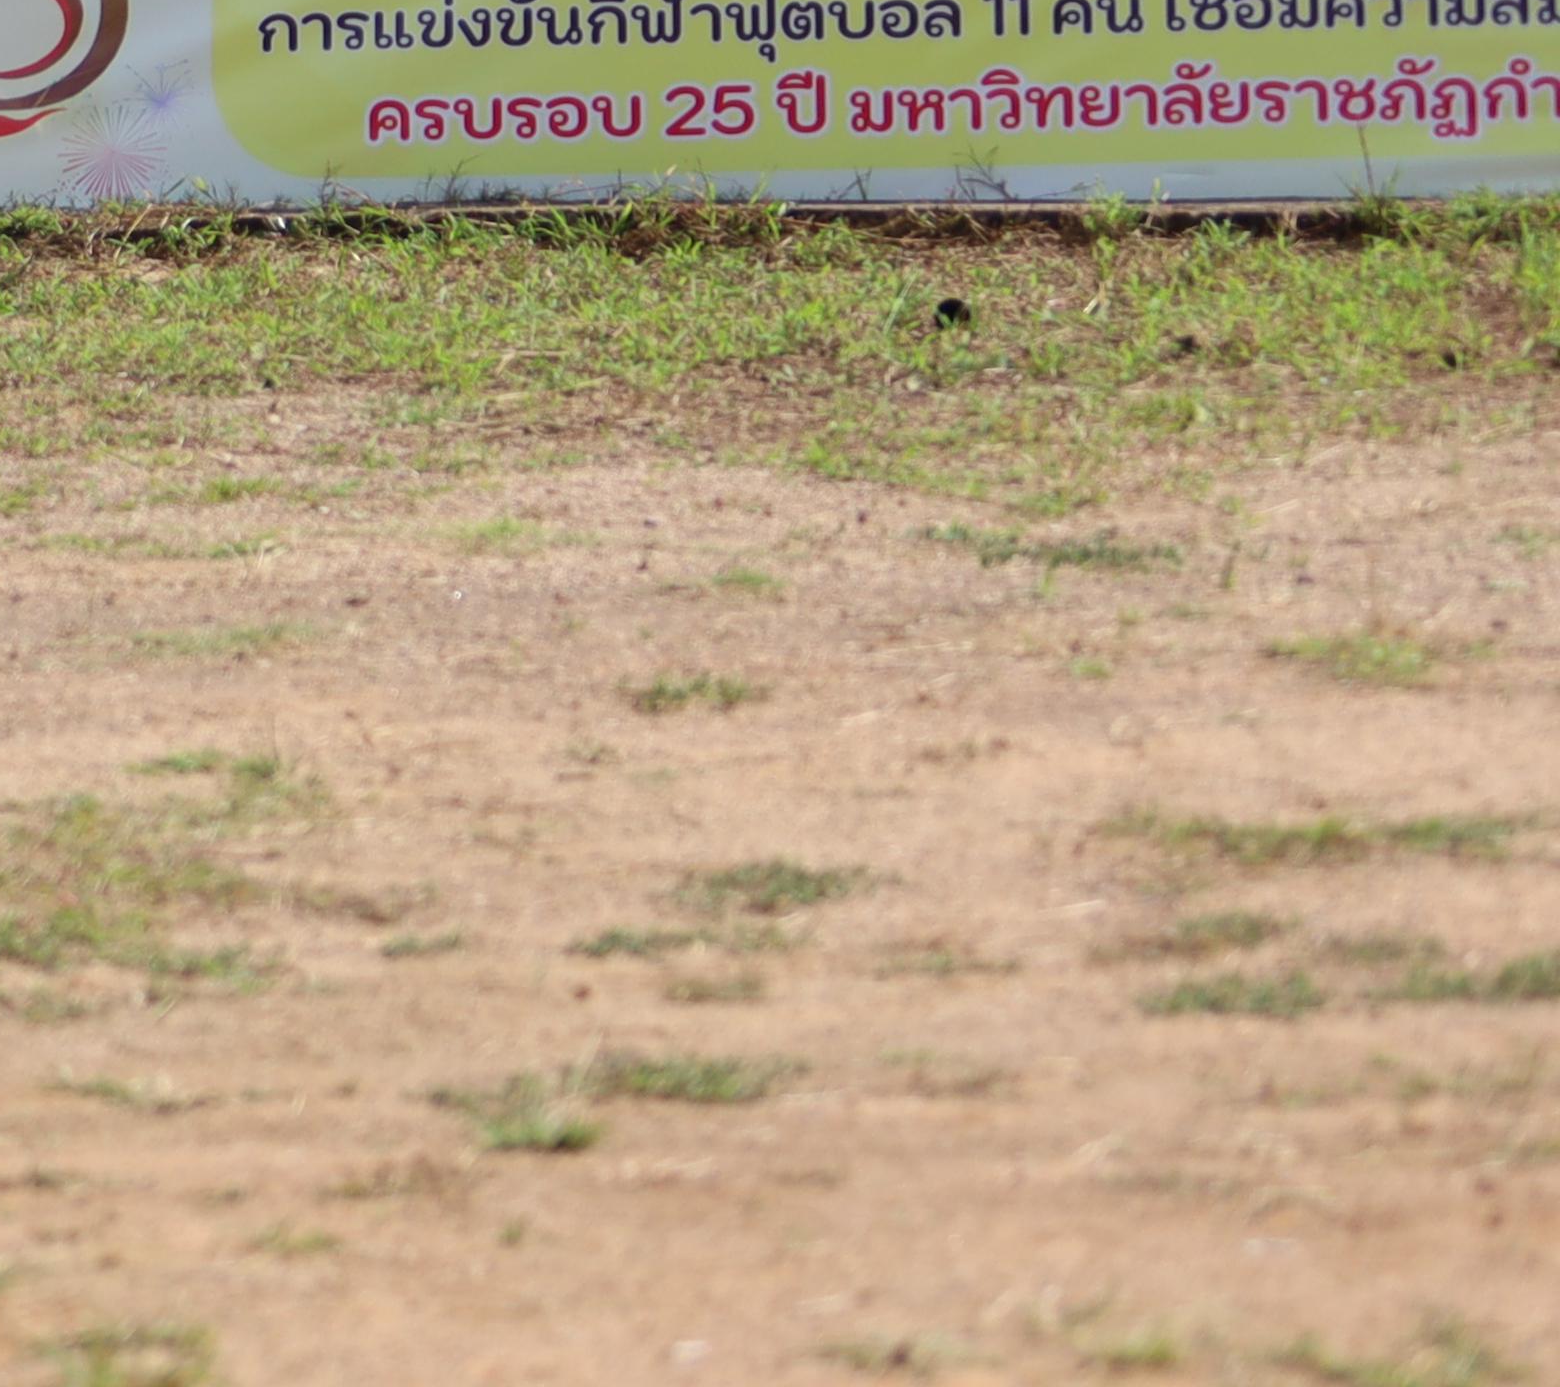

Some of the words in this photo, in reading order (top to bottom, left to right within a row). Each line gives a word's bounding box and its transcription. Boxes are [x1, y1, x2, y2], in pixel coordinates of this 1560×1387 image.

[368, 93, 641, 142] ครบรอบ
[664, 84, 755, 138] 25
[776, 72, 827, 134] ปี
